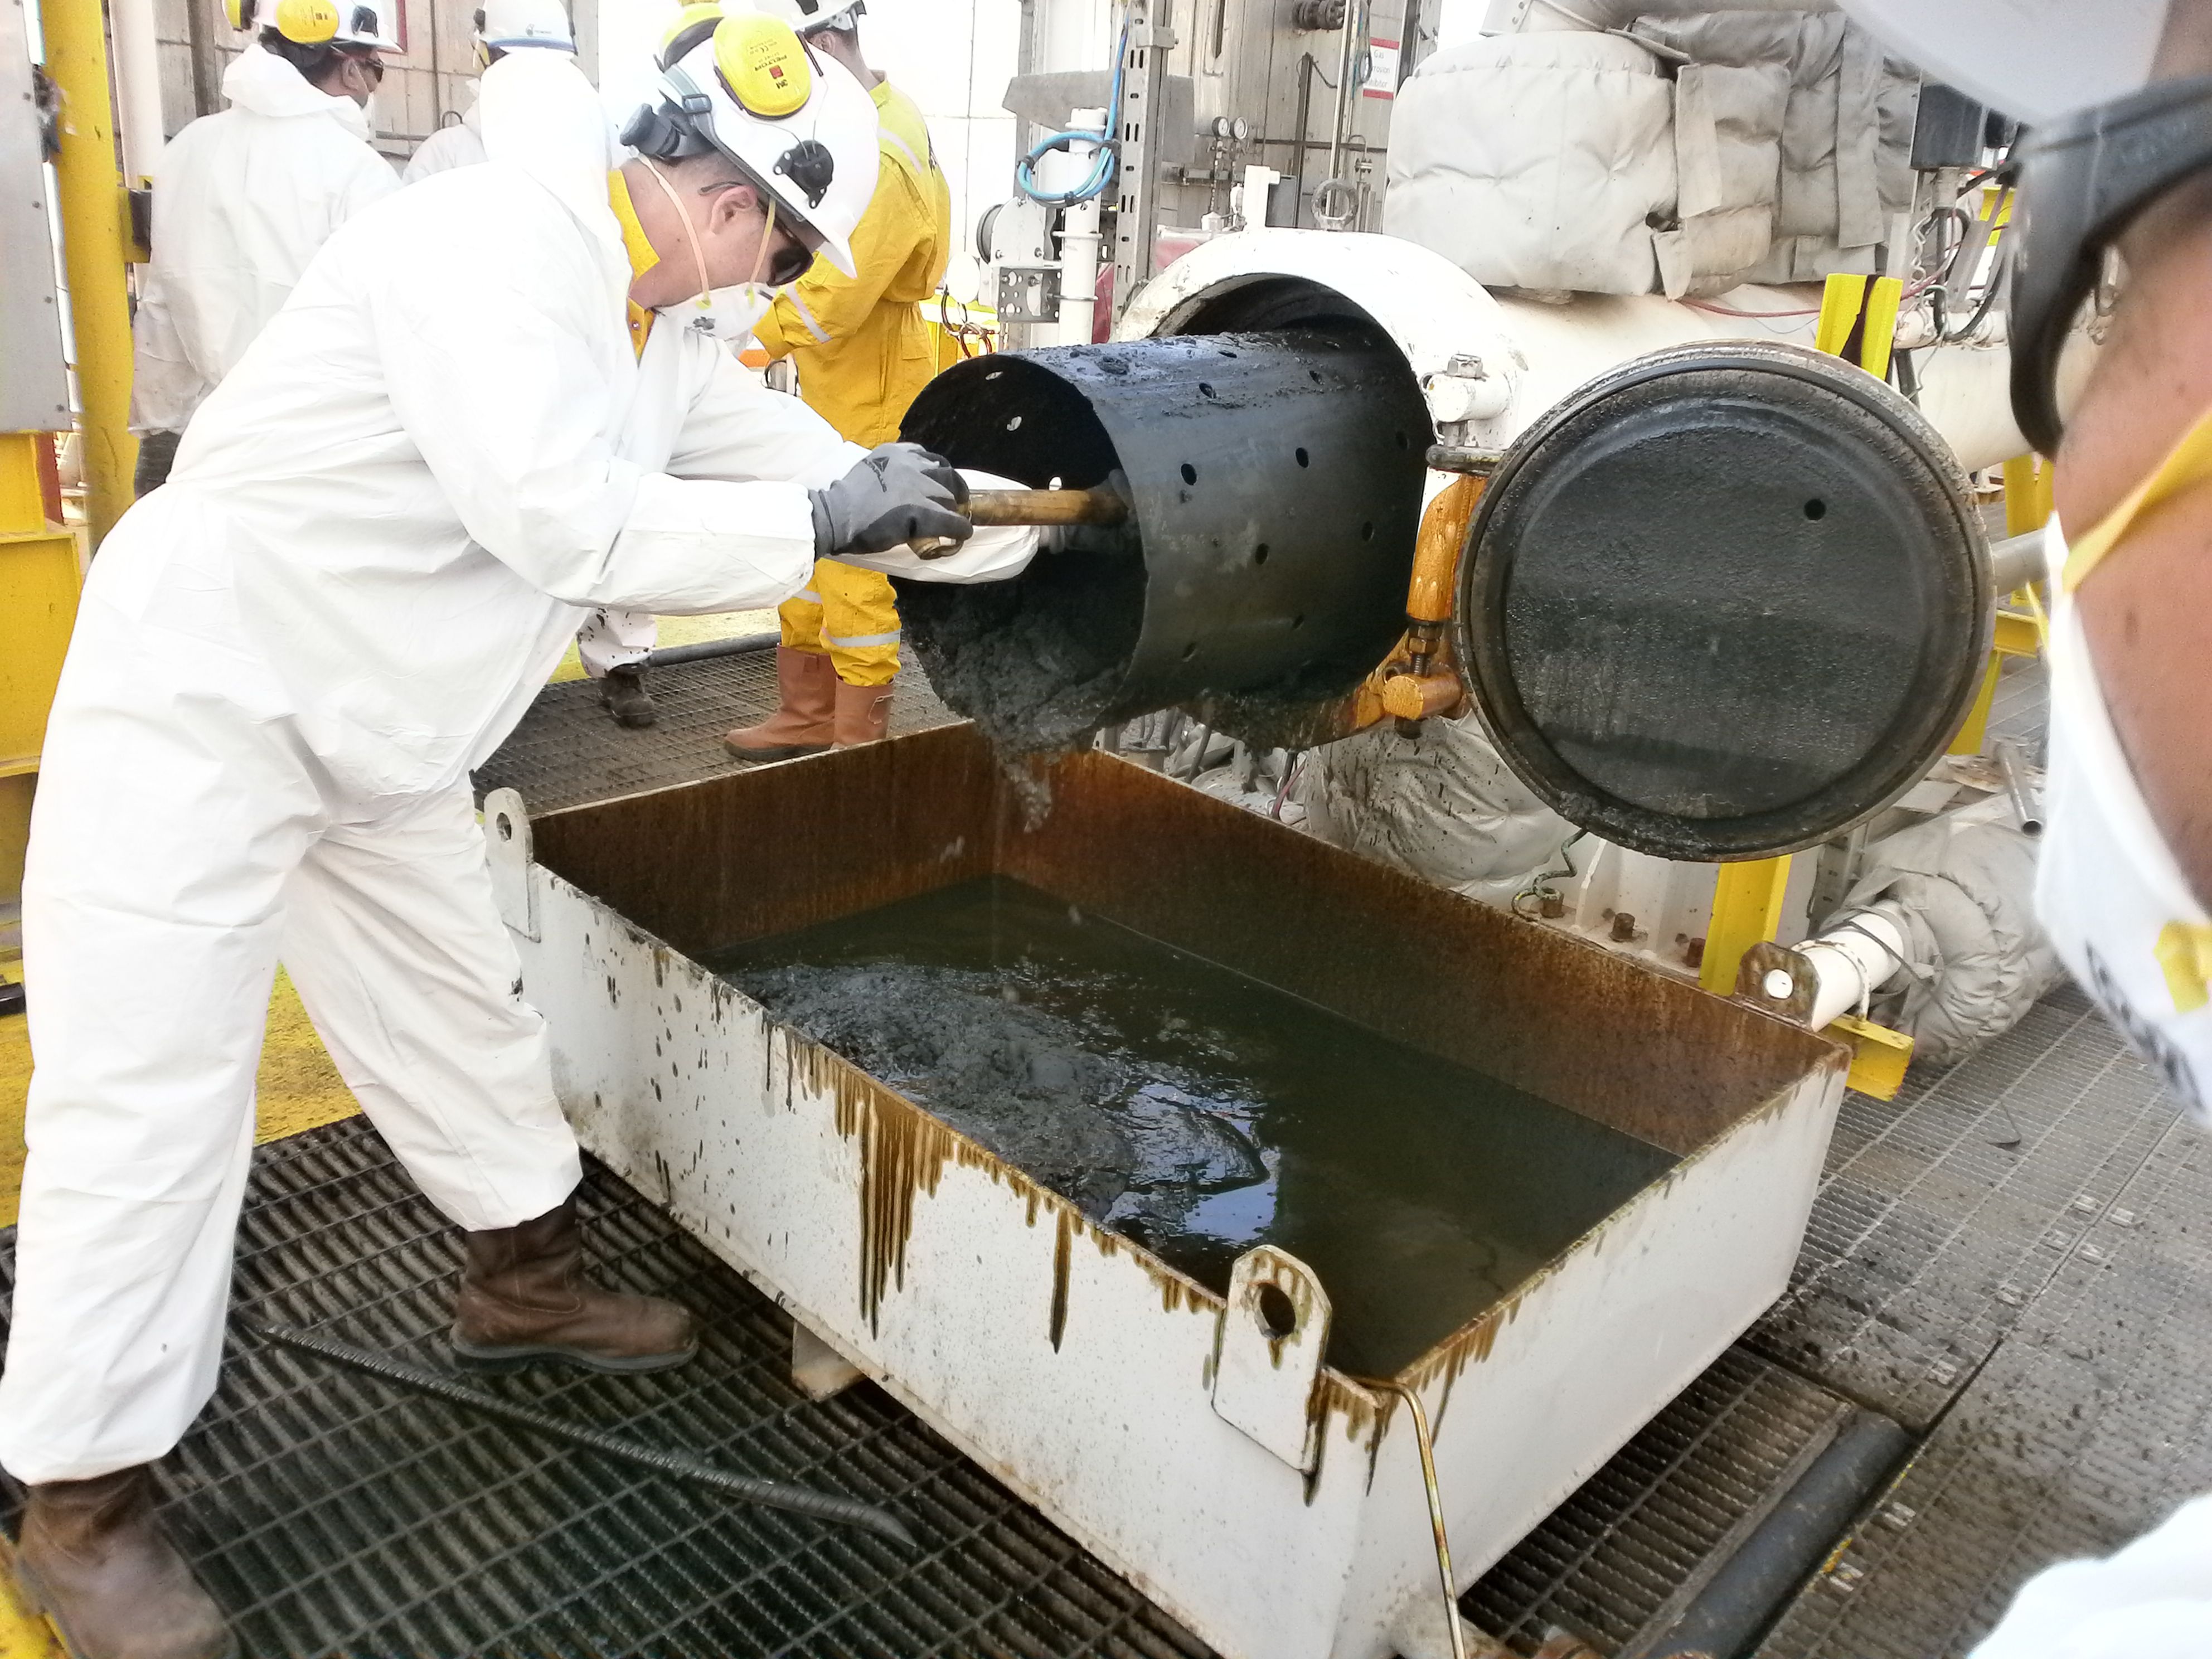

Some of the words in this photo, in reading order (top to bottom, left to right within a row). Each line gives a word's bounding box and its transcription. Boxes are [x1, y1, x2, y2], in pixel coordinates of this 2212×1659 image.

[1374, 49, 1384, 59] Gas
[754, 55, 787, 71] PELTOR
[775, 79, 788, 89] 3M
